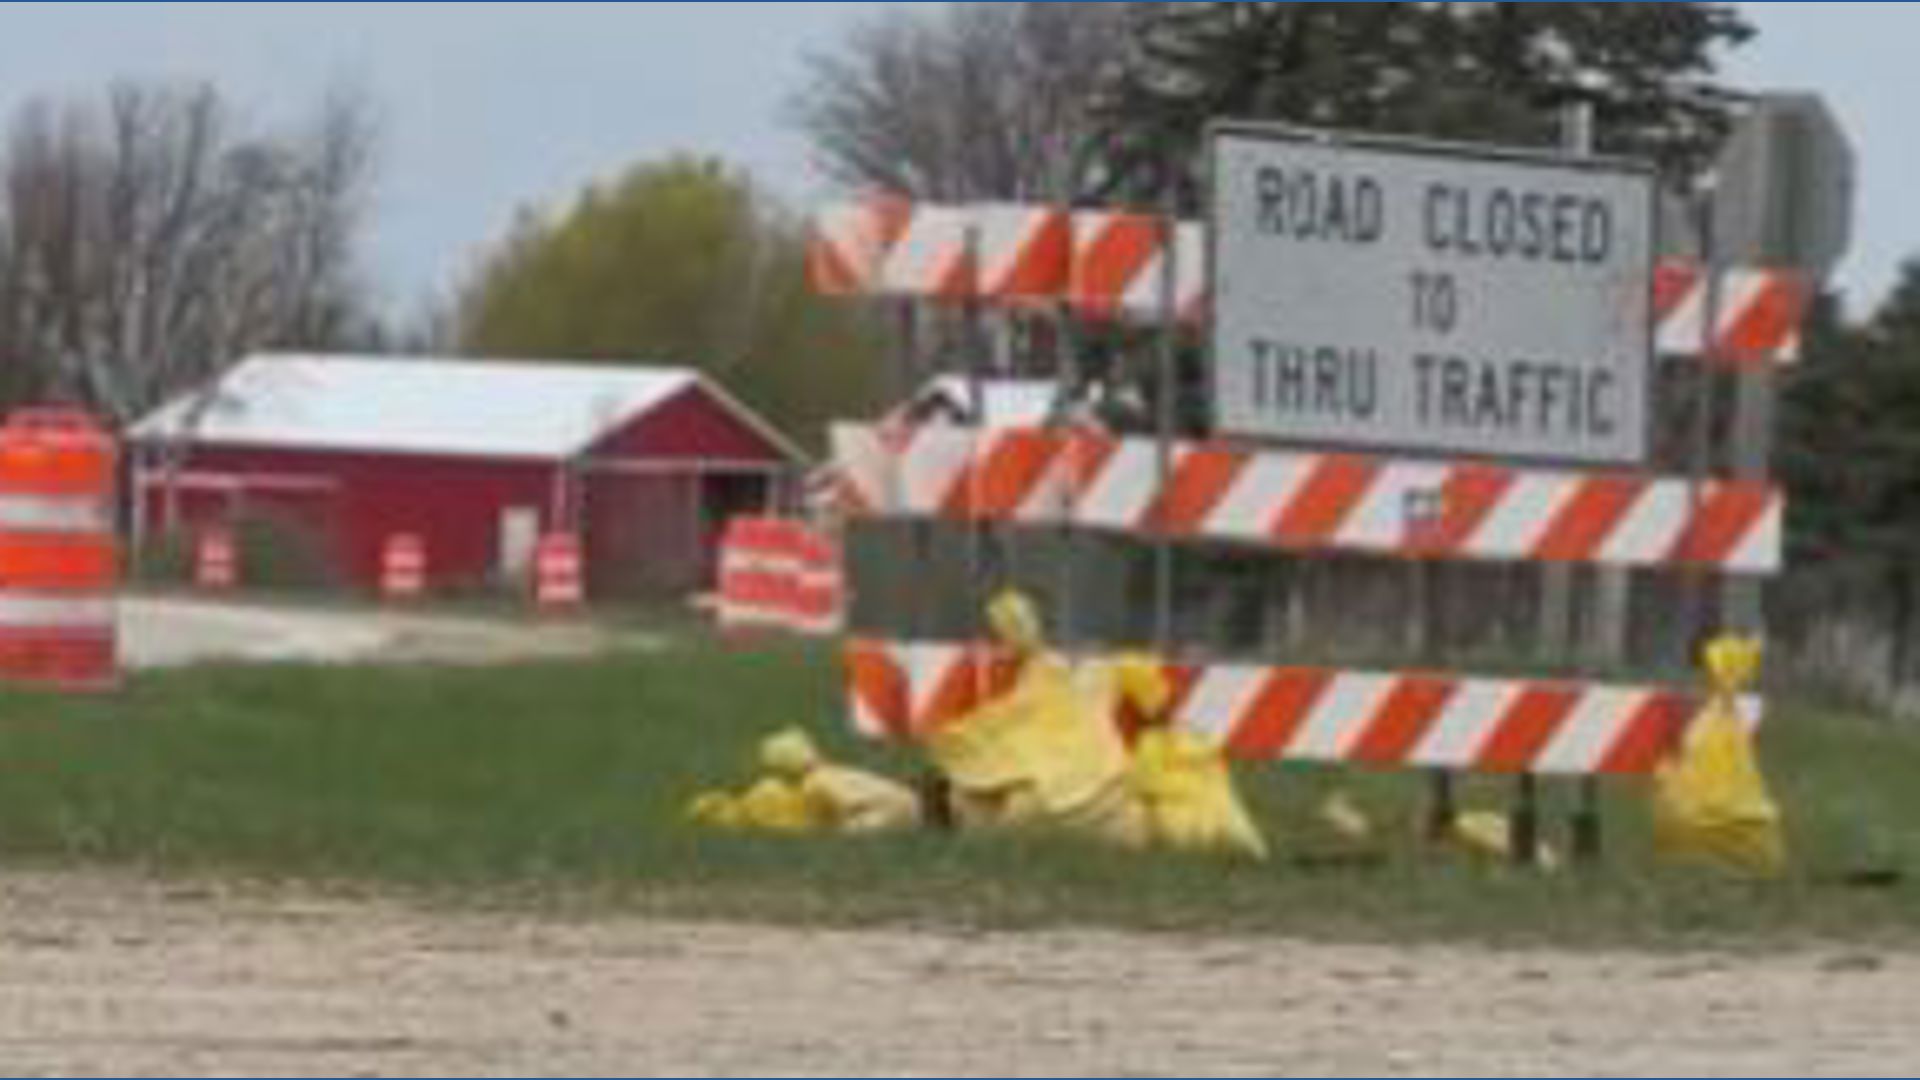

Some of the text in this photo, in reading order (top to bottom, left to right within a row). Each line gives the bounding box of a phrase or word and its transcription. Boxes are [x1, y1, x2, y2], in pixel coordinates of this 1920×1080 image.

[1254, 167, 1612, 262] ROAD CLOSED
[1409, 272, 1456, 334] TO
[1248, 339, 1615, 436] THRU TRAFFIC
